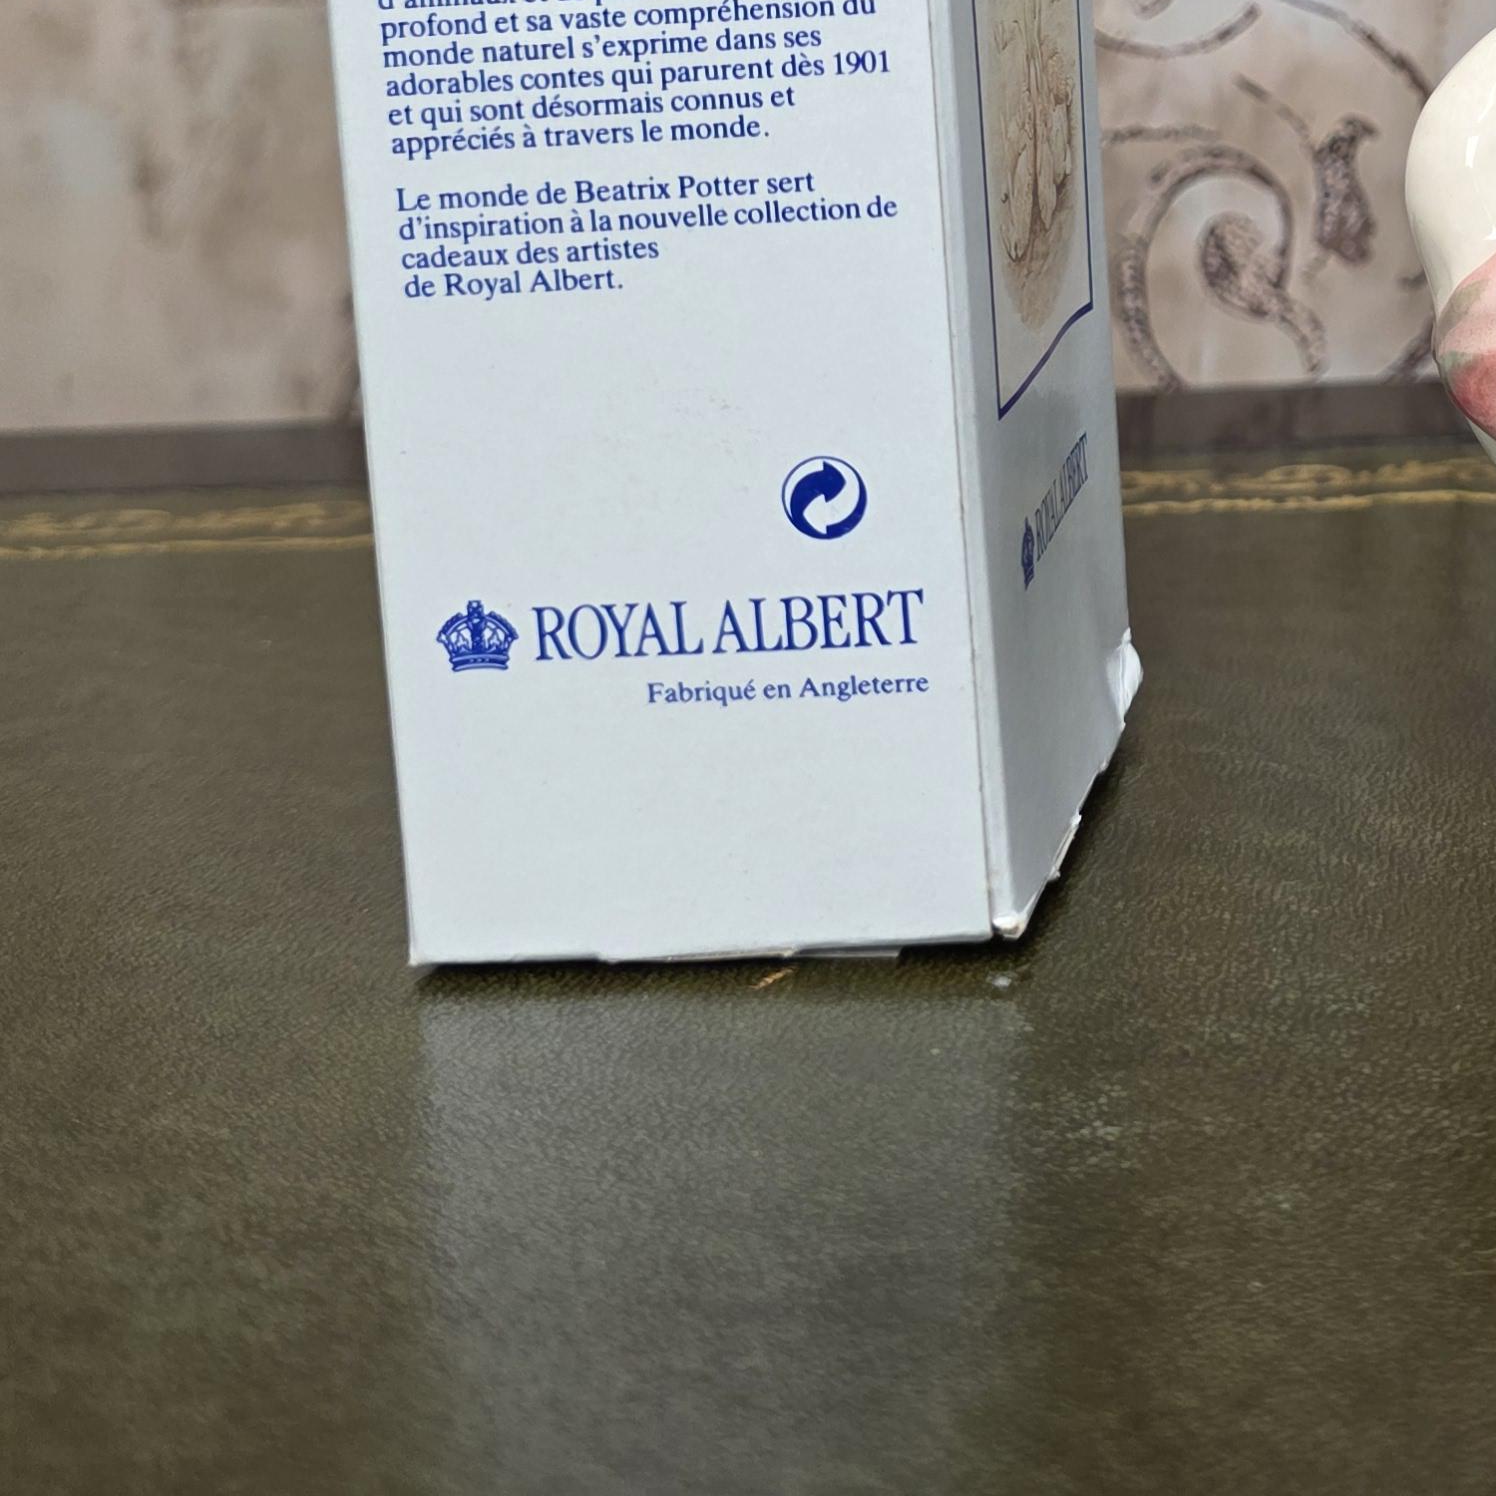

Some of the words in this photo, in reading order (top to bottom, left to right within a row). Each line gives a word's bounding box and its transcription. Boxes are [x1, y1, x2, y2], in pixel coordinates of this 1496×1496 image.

[380, 10, 488, 47] profond
[494, 12, 520, 34] et
[525, 14, 554, 33] sa
[558, 7, 627, 30] vaste
[382, 40, 474, 69] monde
[481, 35, 575, 64] naturel
[581, 30, 709, 63] s'exprime
[715, 27, 777, 52] dans
[783, 29, 822, 49] ses
[386, 68, 514, 98] adorables
[519, 67, 605, 91] contes
[611, 60, 654, 93] qui
[659, 58, 775, 92] parurent
[781, 52, 825, 78] dès
[833, 49, 890, 76] 1901
[388, 104, 414, 127] et
[420, 98, 463, 132] qui
[469, 99, 525, 123] sont
[531, 90, 664, 120] désormais
[670, 91, 764, 113] connus
[770, 86, 796, 108] et
[391, 125, 516, 162] appréciés
[522, 123, 537, 149] à
[543, 126, 635, 148] travers
[640, 118, 664, 143] le
[670, 113, 770, 142] monde.
[395, 187, 432, 213] Le
[438, 182, 529, 210] monde
[535, 181, 568, 206] de
[573, 175, 671, 204] Beatrix
[677, 175, 760, 200] Potter
[766, 172, 816, 195] sert
[398, 211, 565, 246] d'inspiration
[570, 208, 585, 234] à
[589, 208, 613, 233] la
[618, 202, 729, 231] nouvelle
[733, 196, 862, 226] collection
[866, 194, 898, 219] de
[401, 244, 510, 270] cadeaux
[515, 240, 560, 265] des
[566, 236, 660, 263] artistes
[404, 273, 437, 299] de
[443, 269, 522, 302] Royal
[529, 267, 624, 294] Albert.
[532, 600, 705, 662] ROYAL
[711, 587, 924, 655] ALBERT
[646, 677, 757, 708] Fabriqué
[762, 683, 791, 701] en
[798, 674, 930, 702] Angleterre
